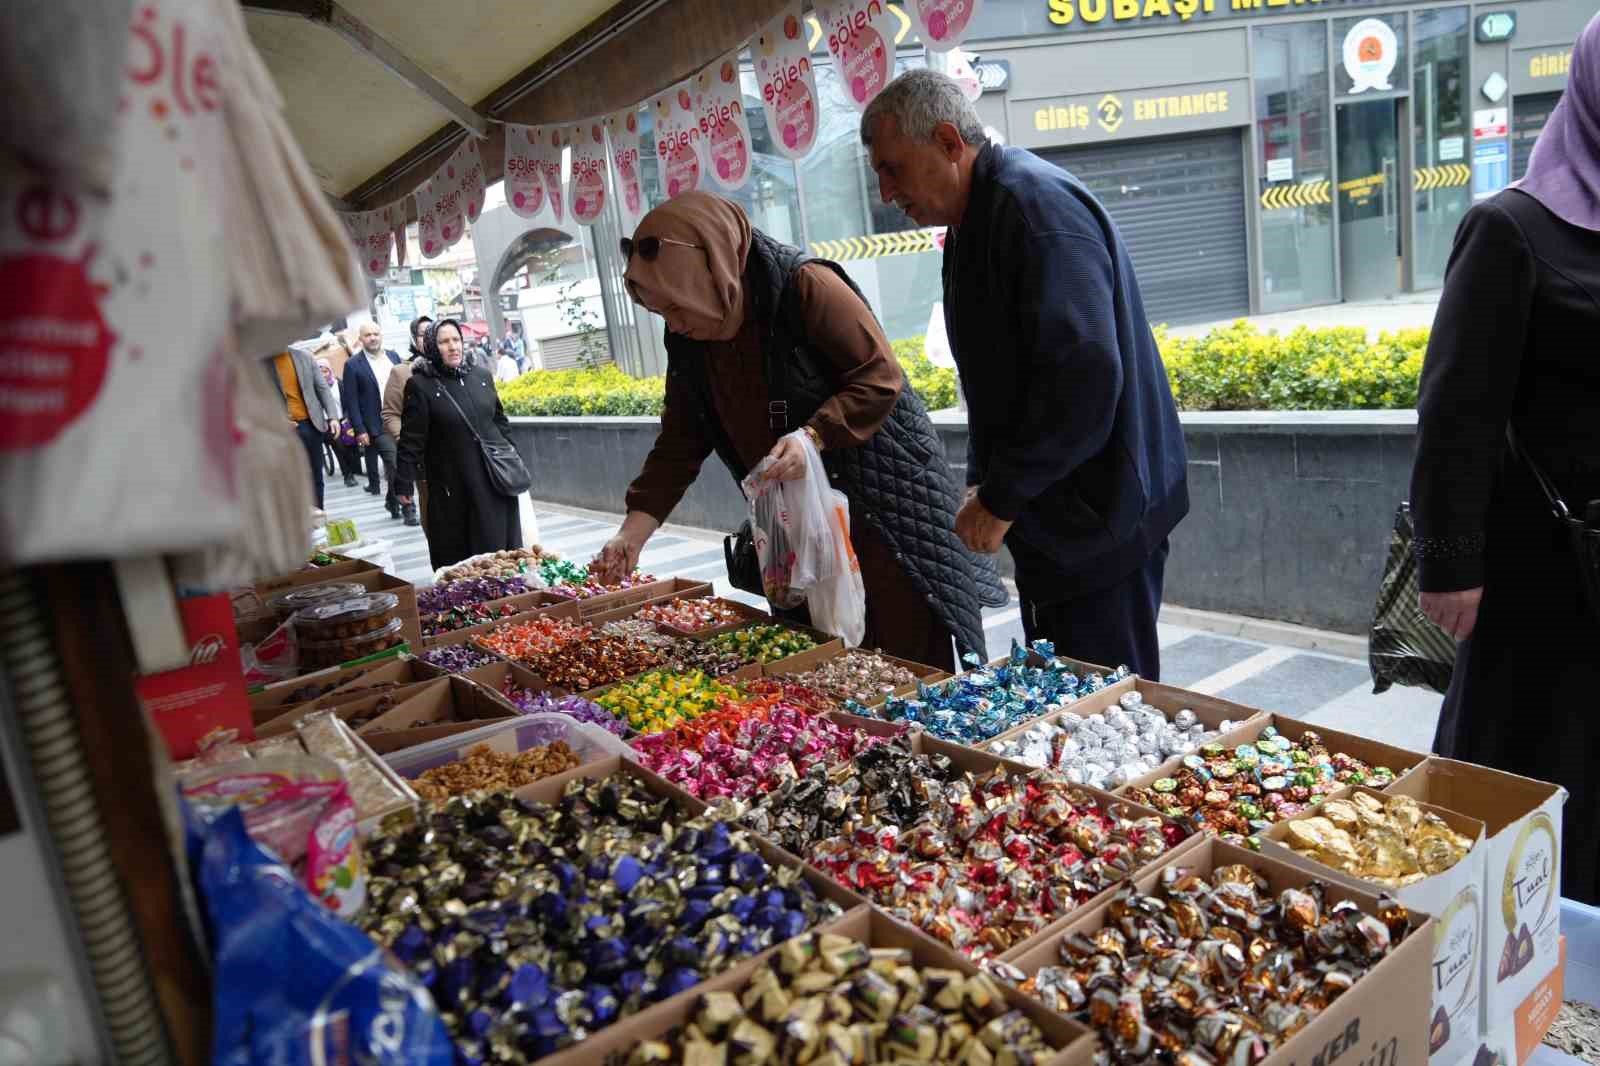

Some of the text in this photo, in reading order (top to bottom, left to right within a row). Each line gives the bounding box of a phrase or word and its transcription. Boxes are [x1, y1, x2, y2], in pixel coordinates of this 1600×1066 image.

[1034, 91, 1229, 131] GİRİŞ 2 ENTRANCE
[1511, 856, 1549, 909] Tual
[1432, 931, 1473, 991] Tual
